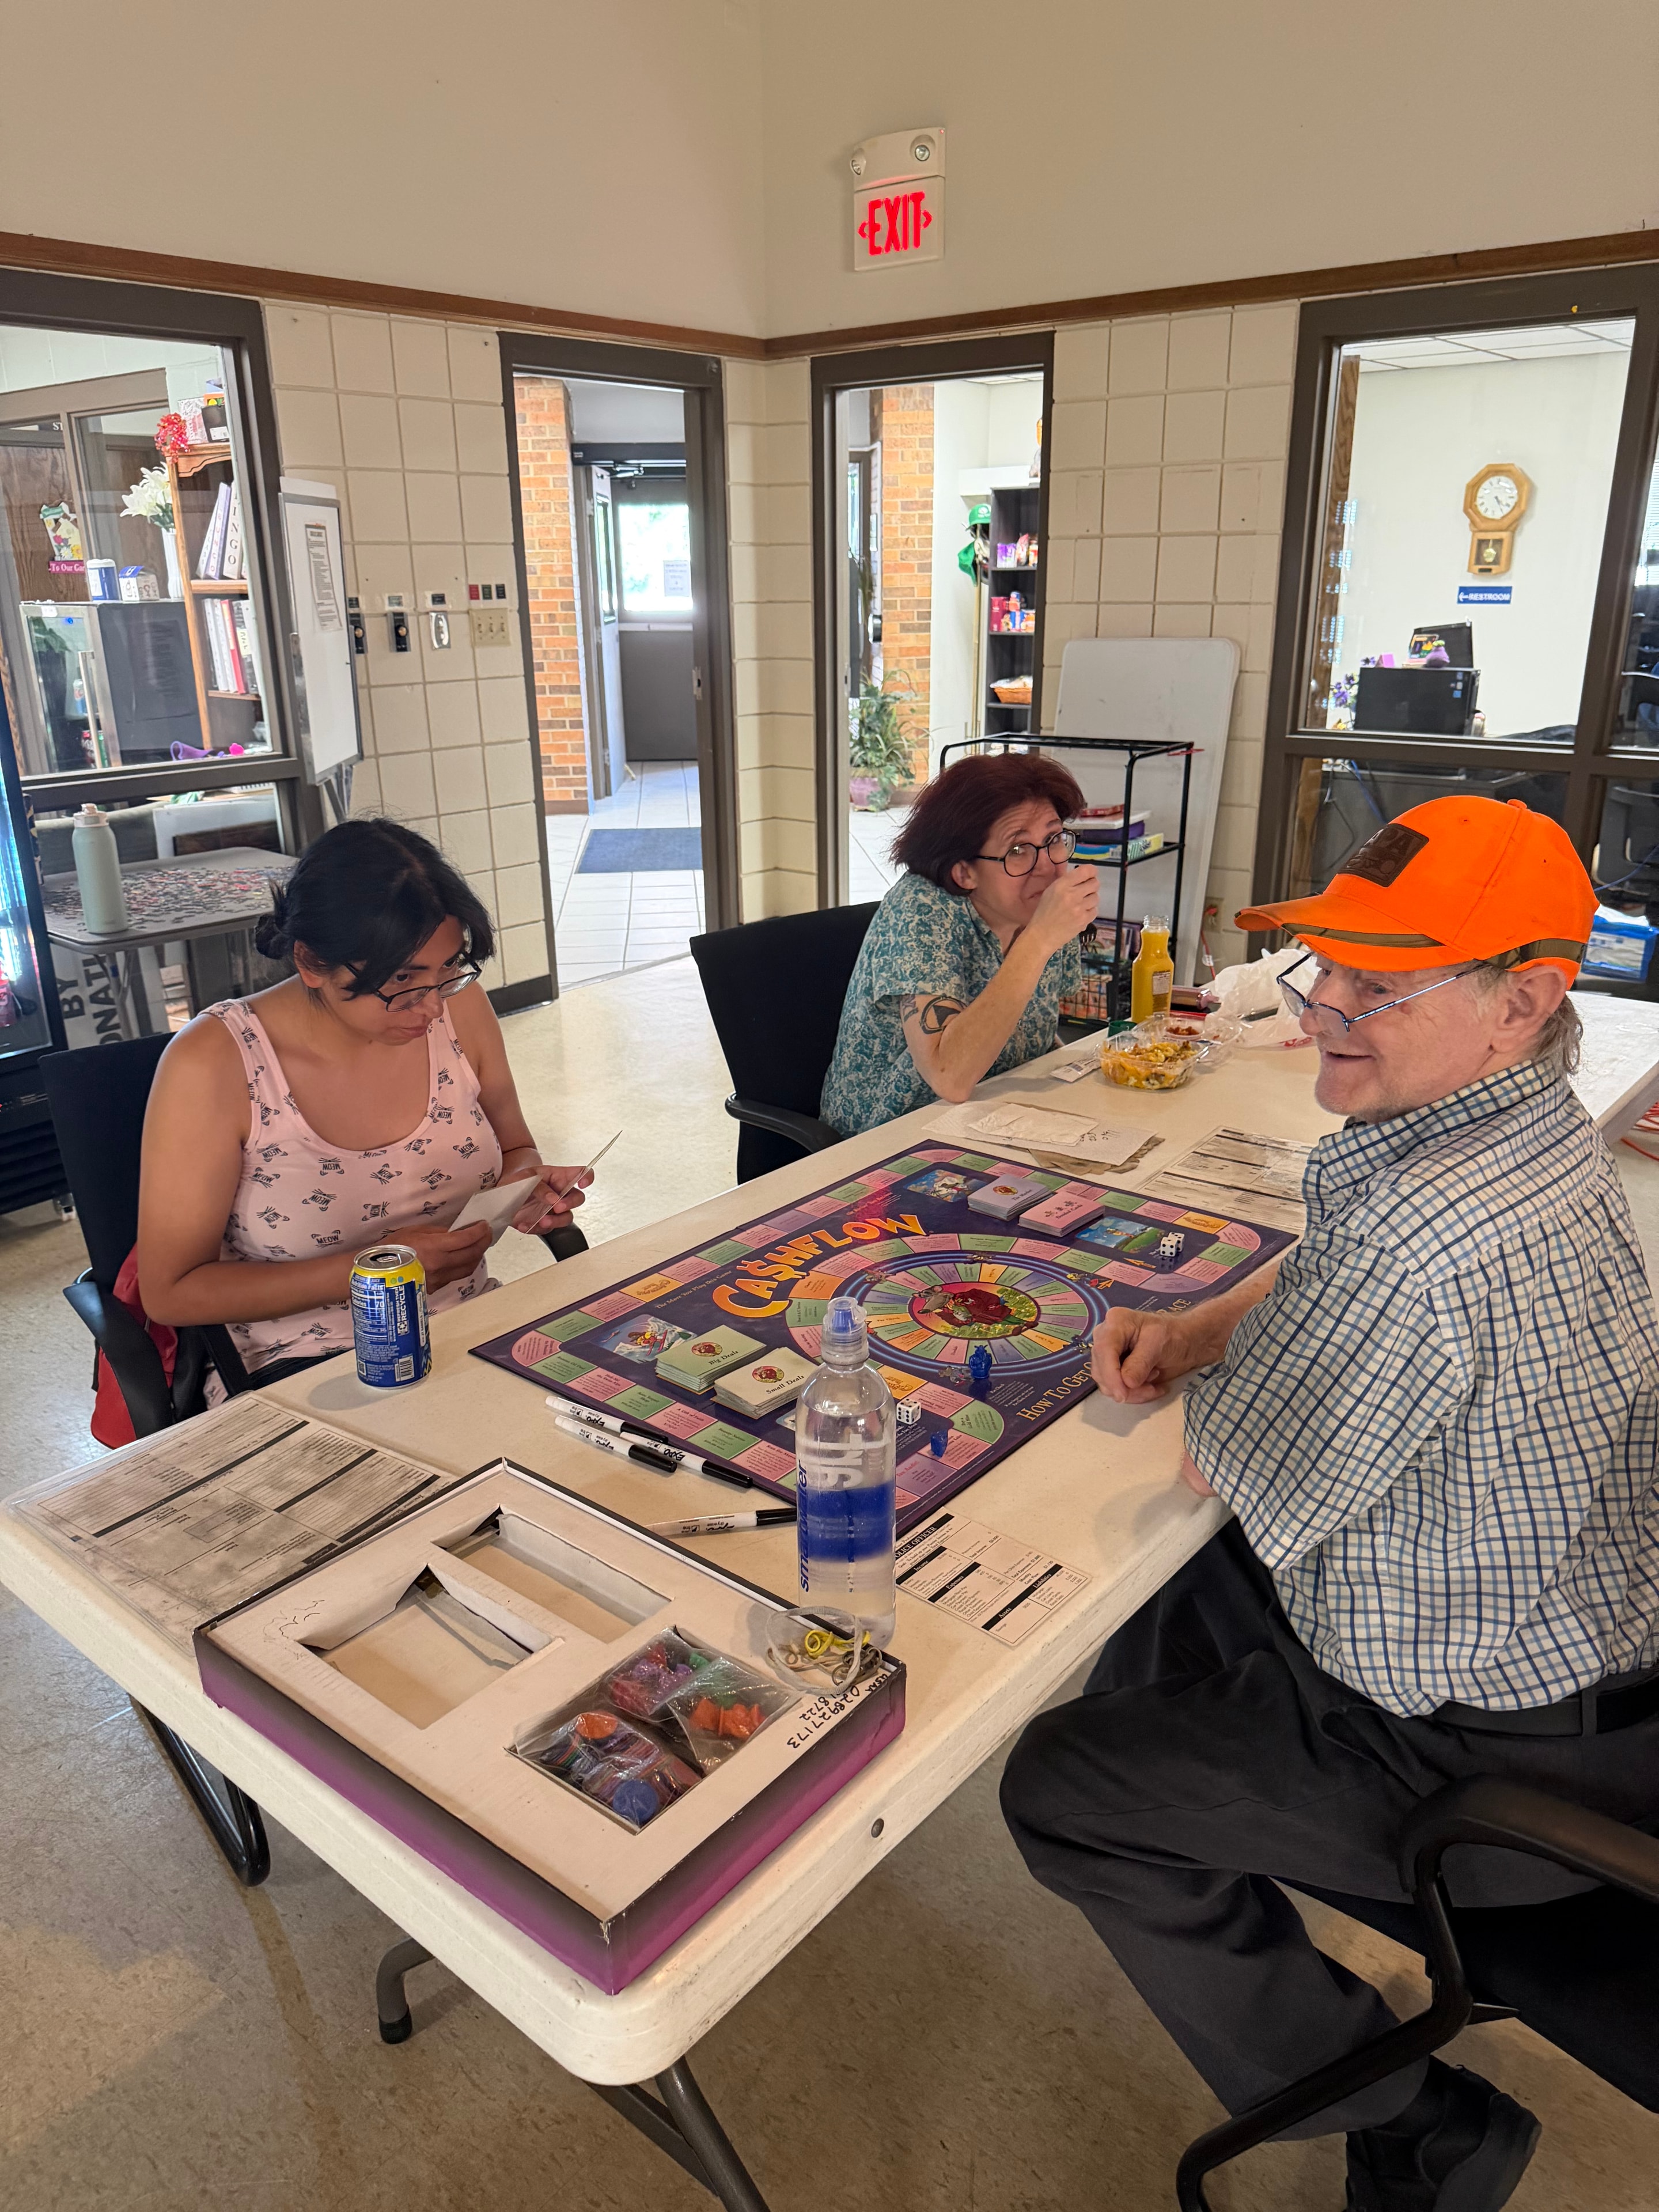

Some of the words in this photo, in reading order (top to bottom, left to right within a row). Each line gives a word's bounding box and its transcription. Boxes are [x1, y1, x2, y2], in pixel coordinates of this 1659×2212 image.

[868, 191, 925, 256] EXIT
[1468, 593, 1510, 601] RESTROOM
[56, 978, 85, 1019] BY
[459, 1142, 475, 1154] MEOW
[309, 1195, 332, 1206] MEOW
[316, 1235, 339, 1244] MEOW
[709, 1358, 721, 1366] Big
[721, 1350, 739, 1360] Deals
[766, 1383, 785, 1395] Small
[786, 1375, 804, 1385] Deals
[664, 1448, 685, 1461] EXPO
[797, 1459, 809, 1592] smartwater
[895, 1543, 913, 1558] OLICE
[911, 1527, 937, 1544] OFFICER
[914, 1560, 929, 1571] Income
[946, 1576, 964, 1589] Expenses
[998, 1608, 1012, 1618] Assets
[1033, 1574, 1051, 1588] Liabilities
